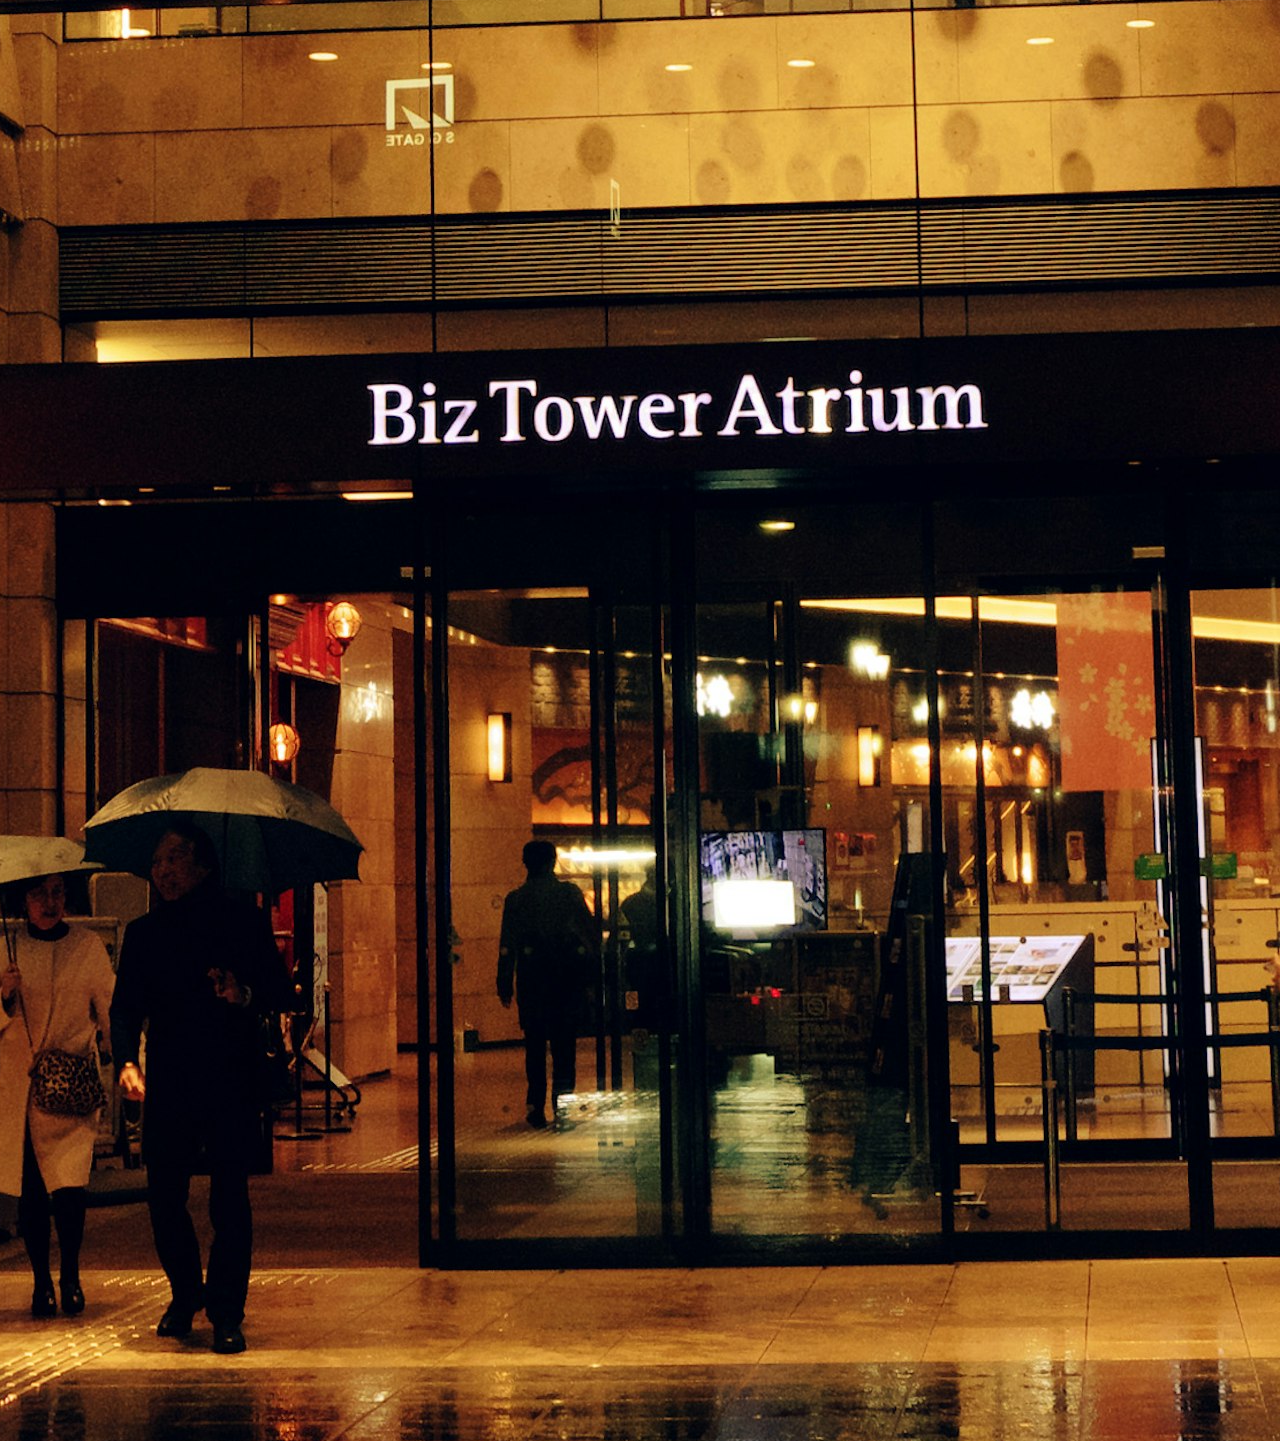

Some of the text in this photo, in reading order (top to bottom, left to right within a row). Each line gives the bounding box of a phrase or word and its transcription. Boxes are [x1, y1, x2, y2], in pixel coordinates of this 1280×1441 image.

[366, 368, 991, 447] Biz Tower Atrium
